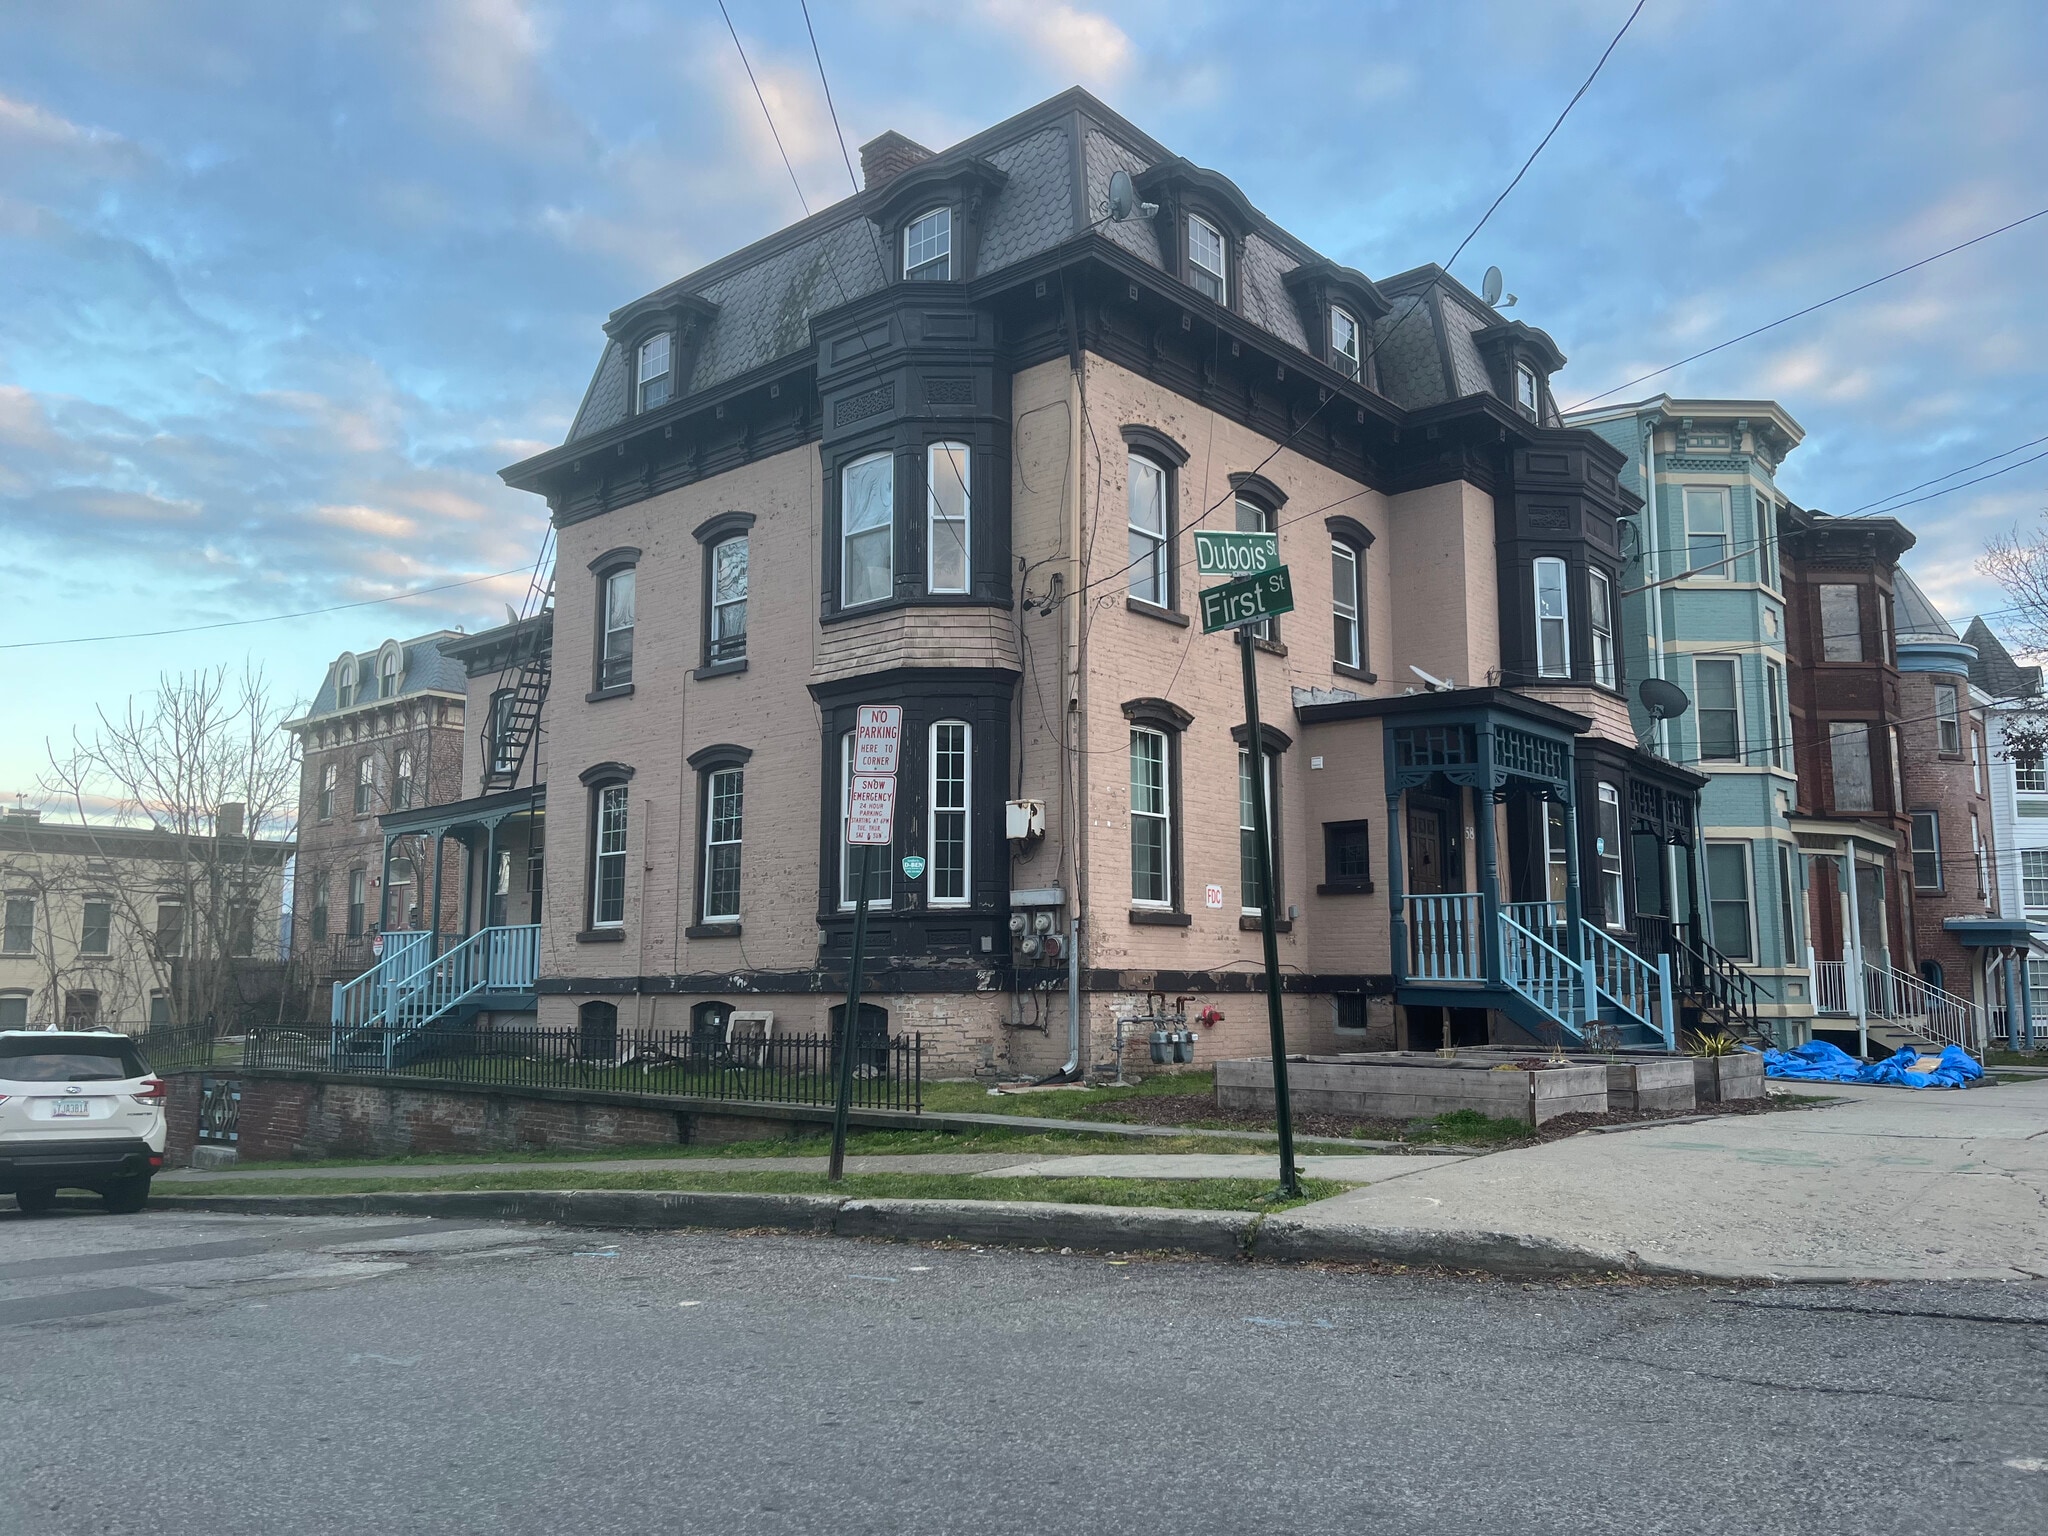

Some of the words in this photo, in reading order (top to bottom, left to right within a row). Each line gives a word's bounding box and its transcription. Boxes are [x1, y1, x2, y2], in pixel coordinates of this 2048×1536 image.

[1197, 537, 1266, 570] Dubois
[1265, 539, 1277, 556] St
[1204, 581, 1266, 627] First
[1269, 574, 1285, 593] St
[871, 710, 888, 723] NO
[859, 726, 897, 739] PARKING
[860, 744, 878, 753] HERE
[885, 744, 894, 753] TO
[862, 756, 890, 766] CORNER
[862, 780, 886, 790] SNOW
[853, 792, 893, 802] EMERGENCY
[1464, 826, 1475, 840] 58
[1207, 888, 1221, 904] FDC
